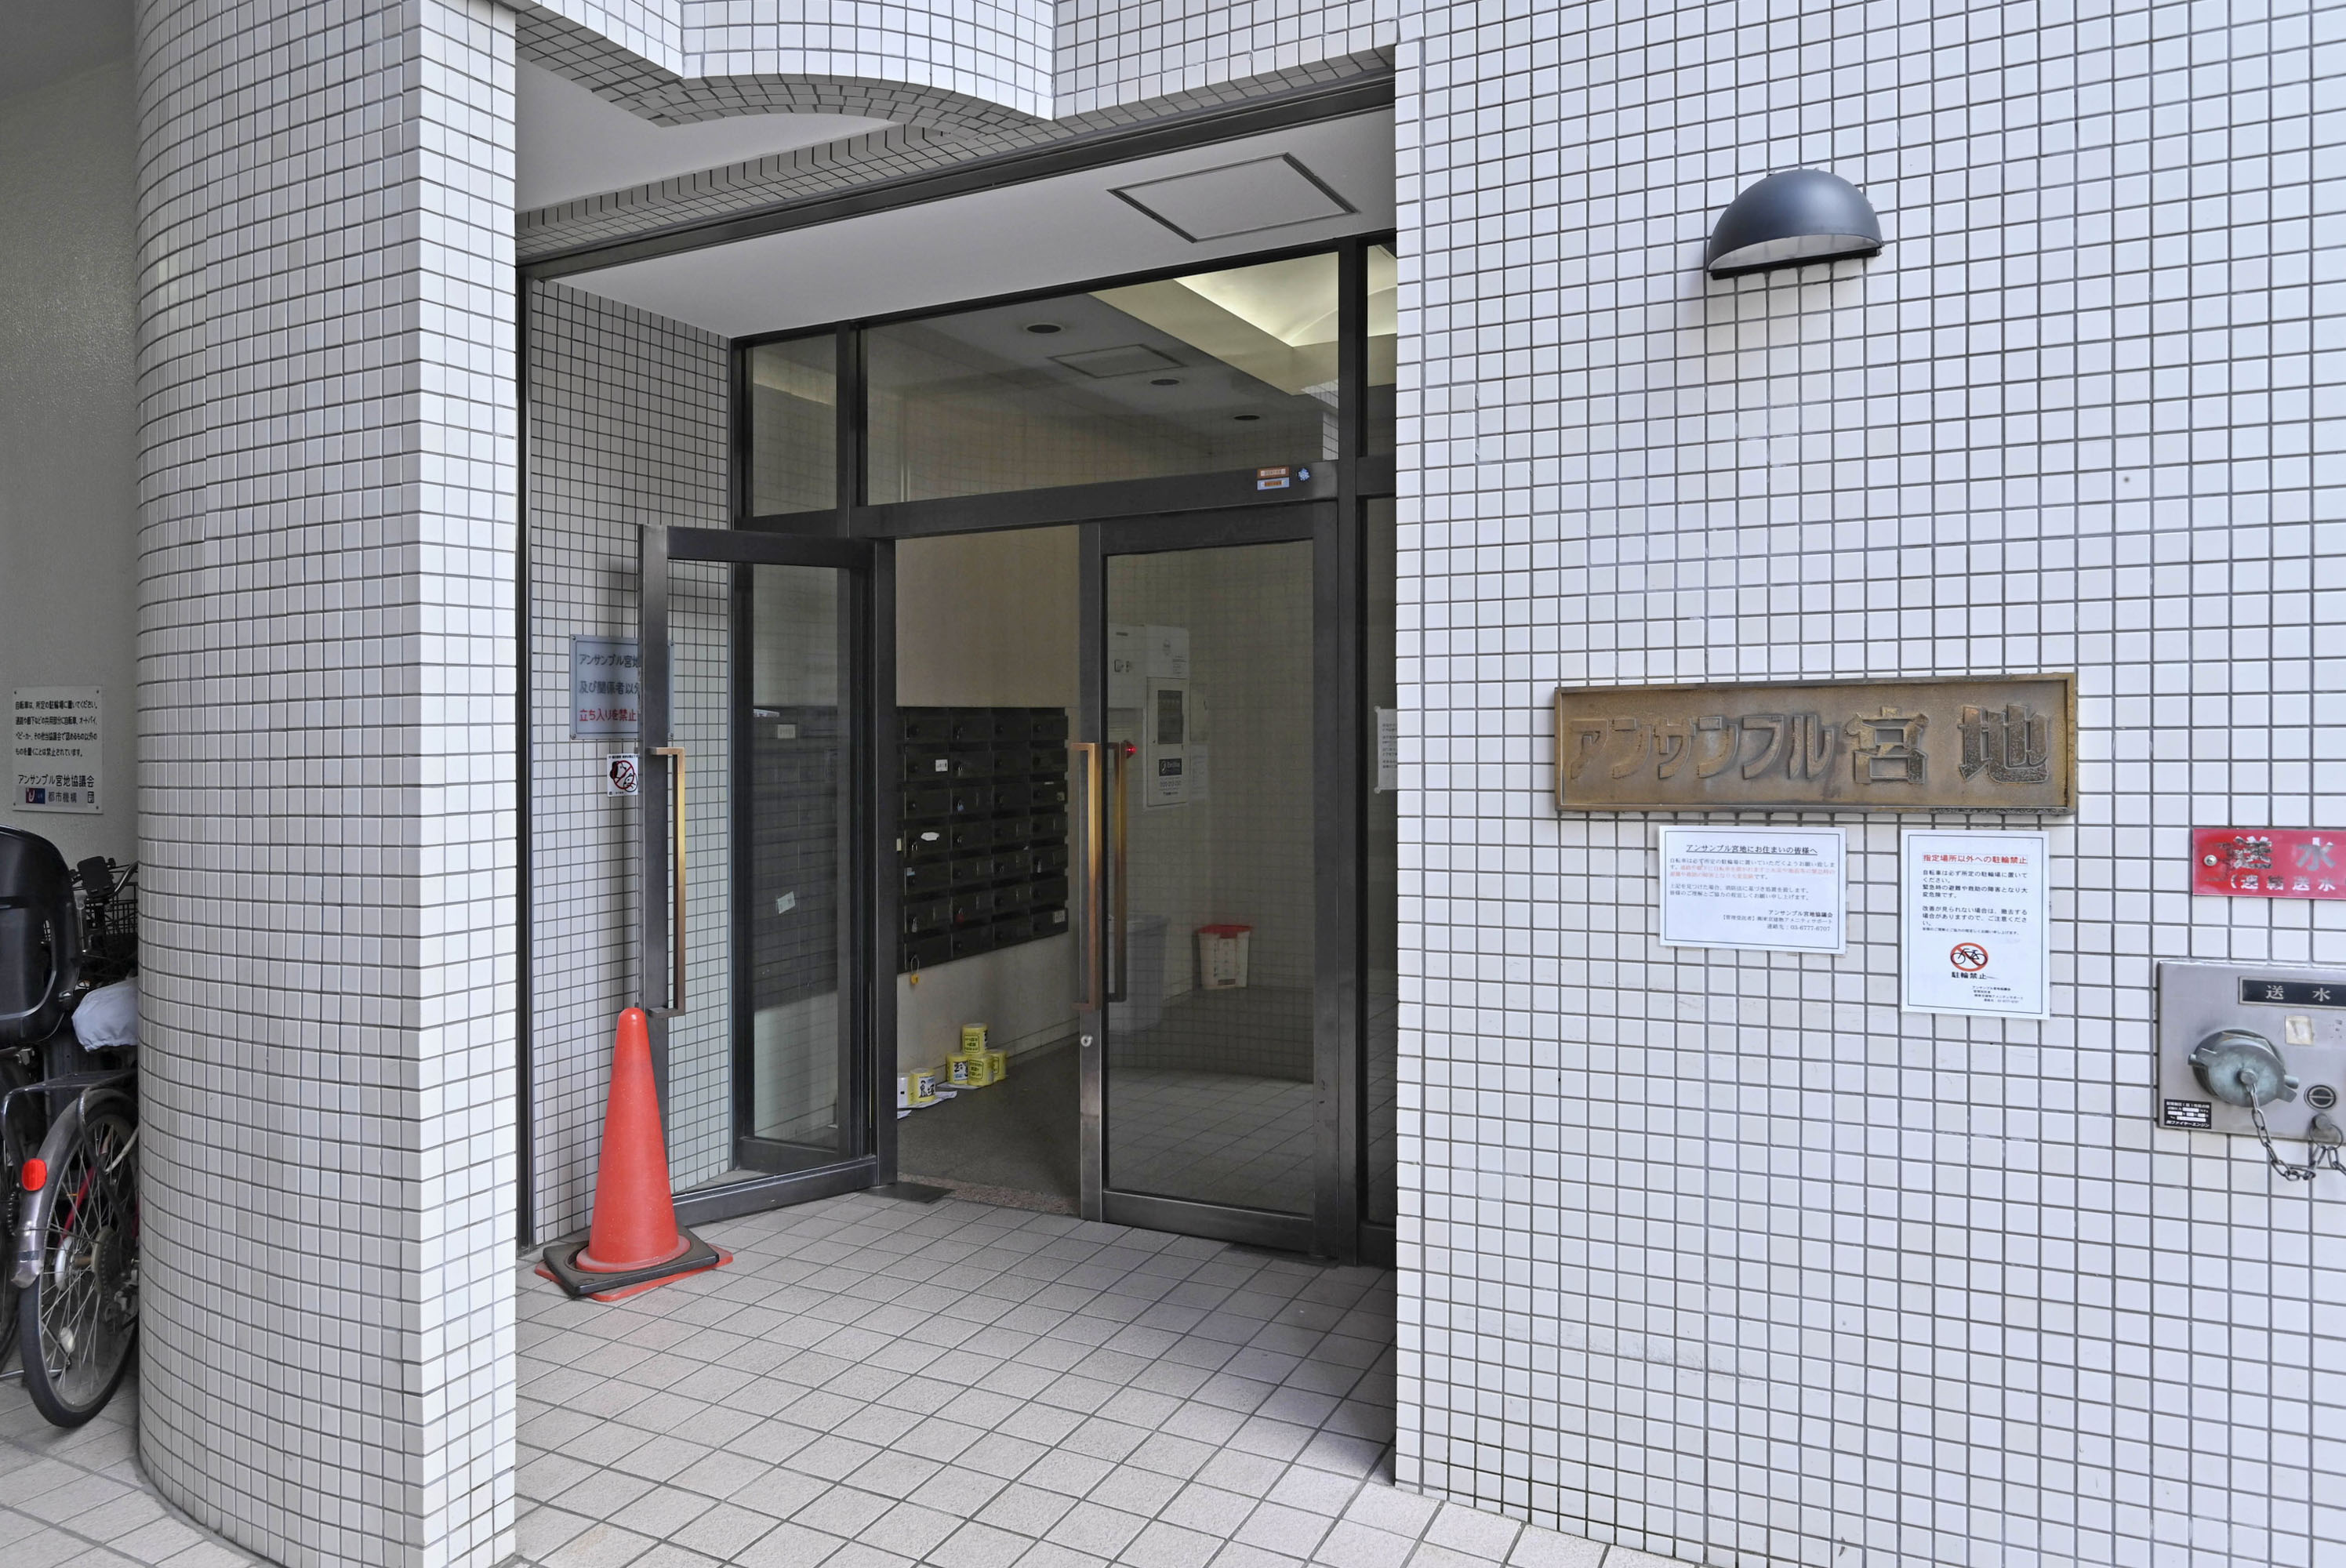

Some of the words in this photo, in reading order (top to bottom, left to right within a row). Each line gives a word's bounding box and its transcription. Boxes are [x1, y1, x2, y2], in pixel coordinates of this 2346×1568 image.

[579, 709, 637, 722] 立ち入りを禁止
[18, 774, 95, 788] アンサンブル宮地協議会
[48, 791, 77, 804] 都市機構
[1686, 844, 1818, 855] アンサンブル宮地にお住まいの皆様へ
[1923, 854, 2028, 865] 指定場所以外への駐輪禁止
[1923, 869, 2028, 879] 自転車は必ず所定の駐輪場に置いて
[1922, 884, 2028, 894] 緊急時の避難や救助の障害となり大
[1768, 909, 1833, 918] アンサンブル宮地協議会
[1922, 906, 2028, 916] 改善が見られない場合は、撤去する
[1922, 913, 2028, 923] 場合がありますので、ご注意くださ
[1951, 971, 1988, 980] 駐輪禁止
[2265, 985, 2331, 1002] 送水
